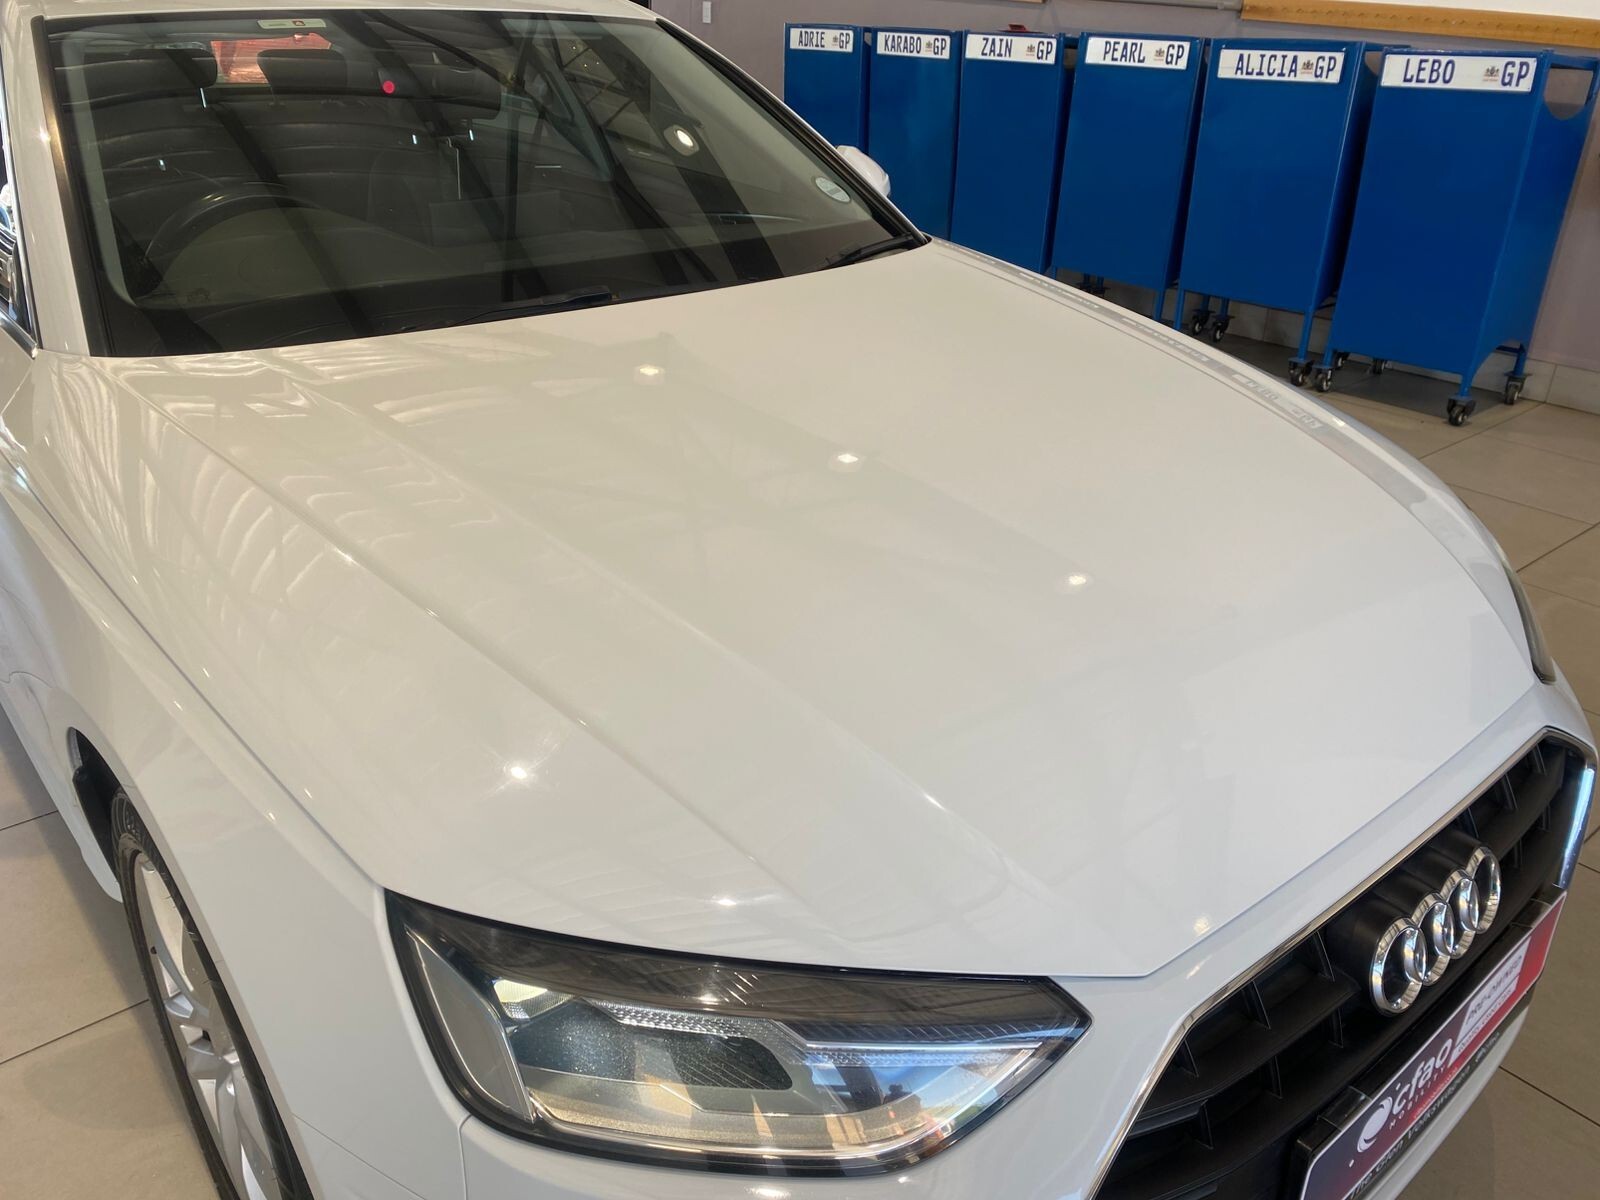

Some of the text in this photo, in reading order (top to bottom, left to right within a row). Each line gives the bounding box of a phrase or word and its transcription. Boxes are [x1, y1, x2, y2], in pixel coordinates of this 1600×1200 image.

[798, 30, 851, 50] ADRIE GP
[884, 35, 947, 56] KARABO GP
[980, 38, 1053, 61] ZAIN GP
[1103, 40, 1185, 66] PEARL GP
[1234, 53, 1337, 80] ALICIA GP
[1402, 58, 1530, 87] LEBO GP
[1392, 1038, 1453, 1115] cfao
